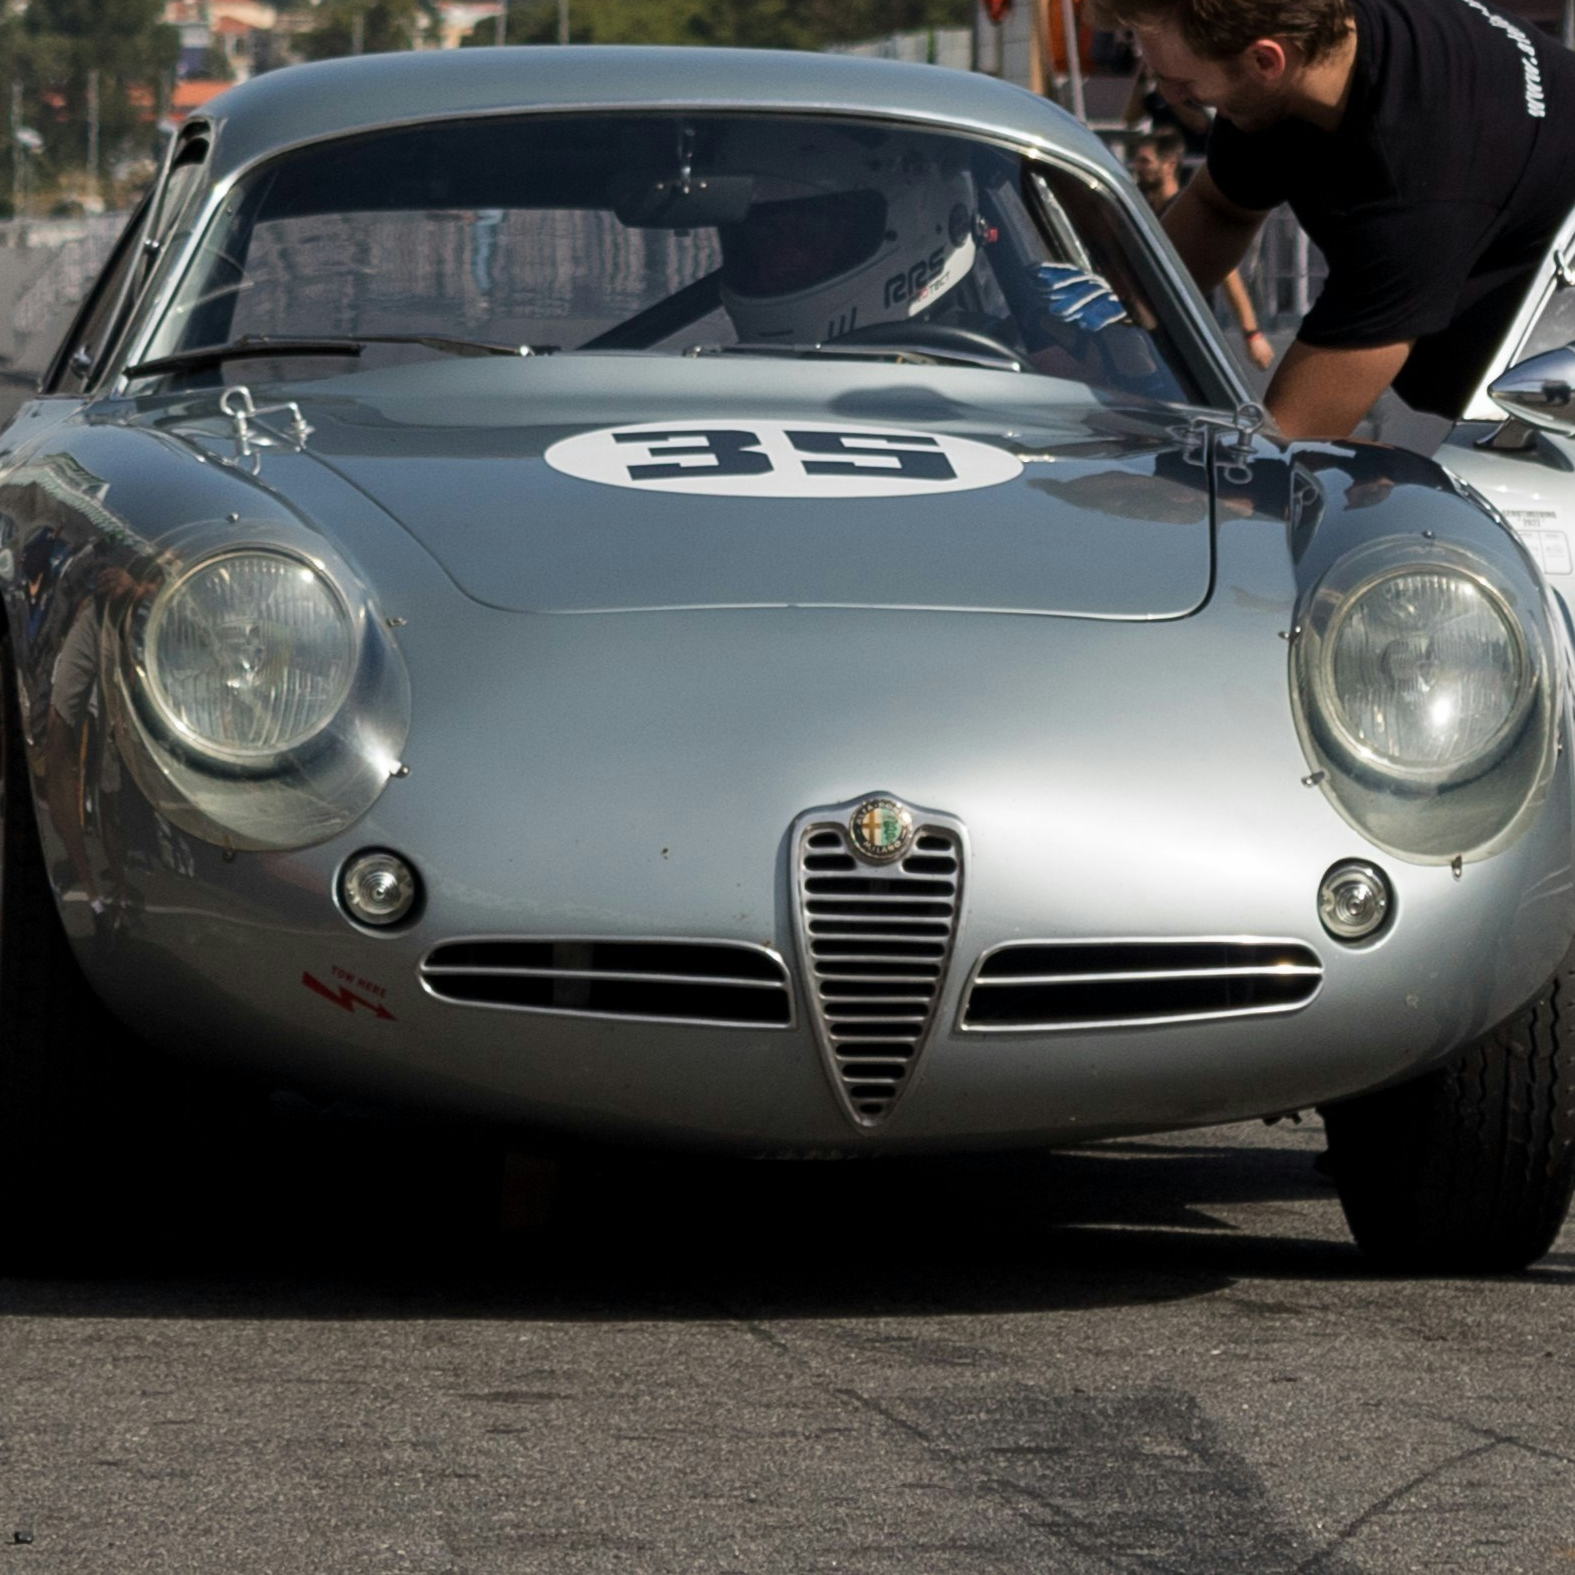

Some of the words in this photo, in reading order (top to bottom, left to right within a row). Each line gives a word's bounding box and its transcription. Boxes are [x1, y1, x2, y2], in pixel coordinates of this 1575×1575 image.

[884, 246, 945, 309] RRS
[612, 429, 958, 481] 35
[331, 965, 356, 983] TOW
[357, 977, 386, 999] HERE
